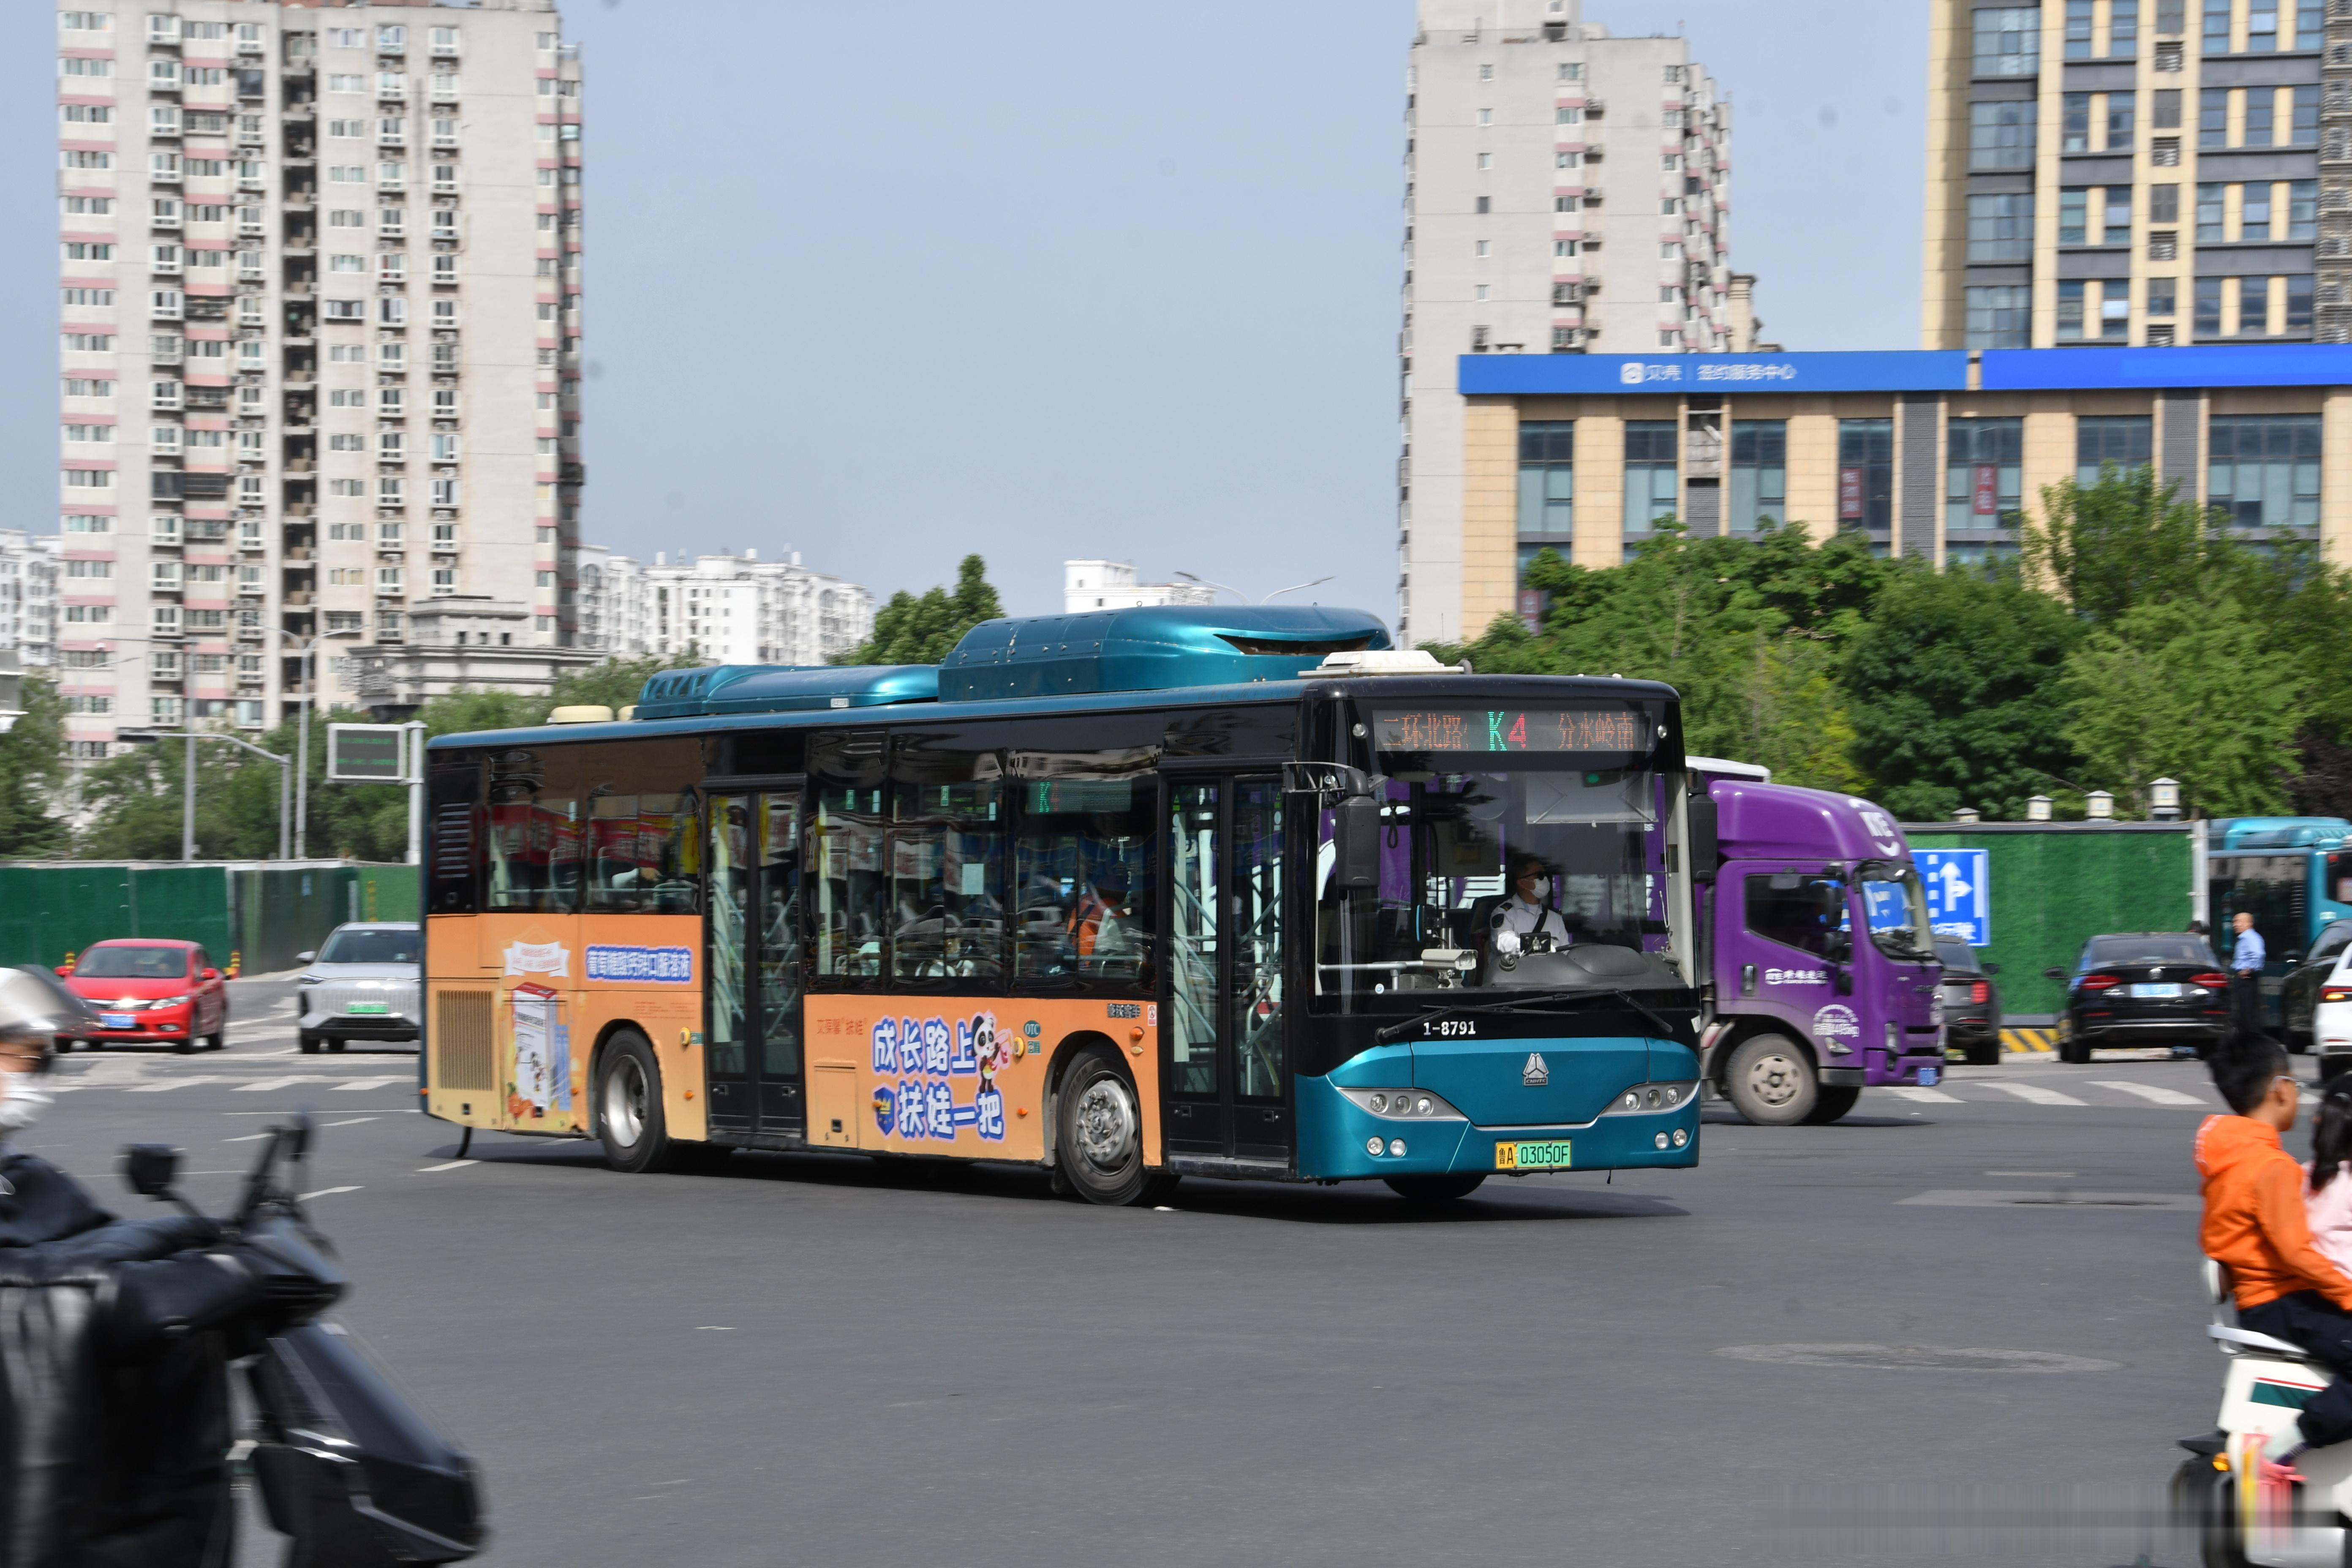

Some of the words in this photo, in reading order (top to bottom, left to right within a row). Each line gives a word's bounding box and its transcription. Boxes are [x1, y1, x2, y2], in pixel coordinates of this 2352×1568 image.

[1487, 711, 1526, 751] K4
[873, 1021, 975, 1072] 成长路上
[1423, 1021, 1476, 1035] 1-8791
[898, 1082, 1002, 1137] 扶娃一把
